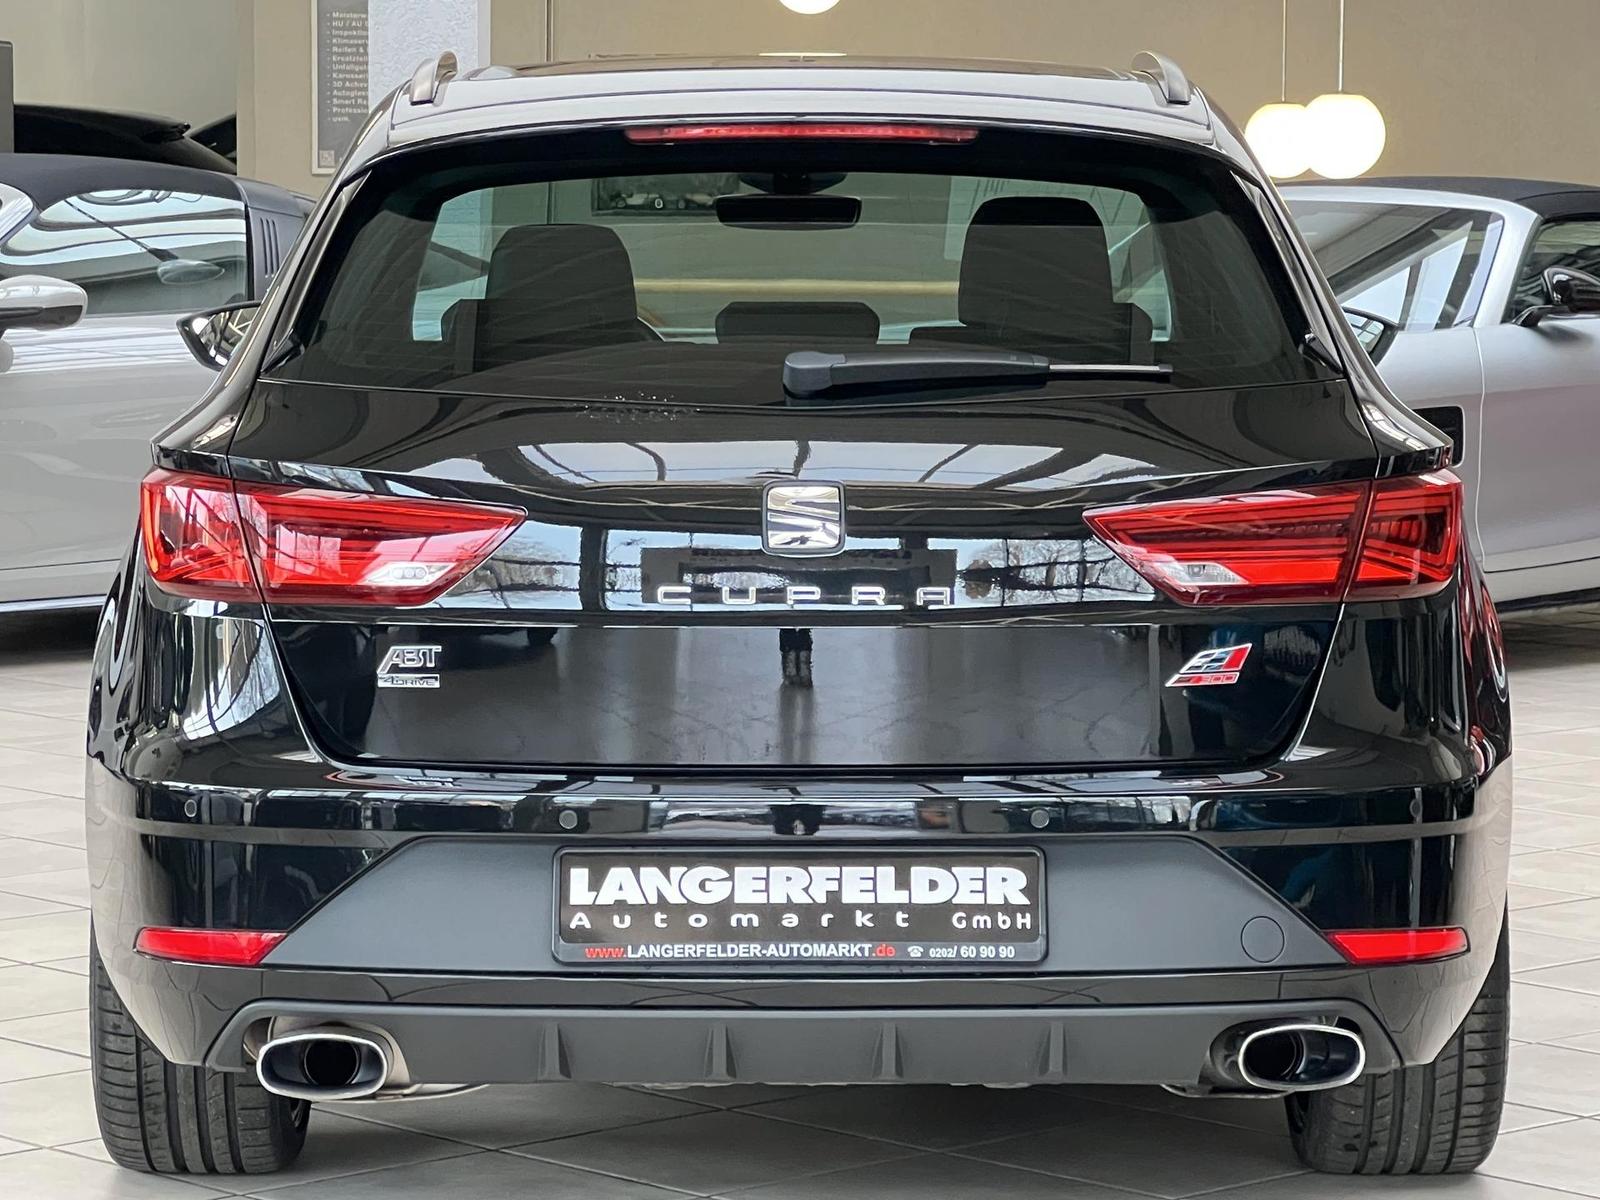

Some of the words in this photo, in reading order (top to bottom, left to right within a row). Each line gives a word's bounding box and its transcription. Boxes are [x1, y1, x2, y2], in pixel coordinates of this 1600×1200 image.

[657, 584, 952, 606] CUPRA
[376, 645, 442, 674] ABT
[569, 866, 1031, 906] LANGERFELDER
[569, 911, 910, 930] Automarkt
[951, 911, 1032, 930] GmbH
[585, 943, 896, 958] www.LANGERFELDER-AUTOMARKT.de
[960, 945, 977, 958] 60
[979, 945, 996, 958] 90
[998, 945, 1015, 958] 90
